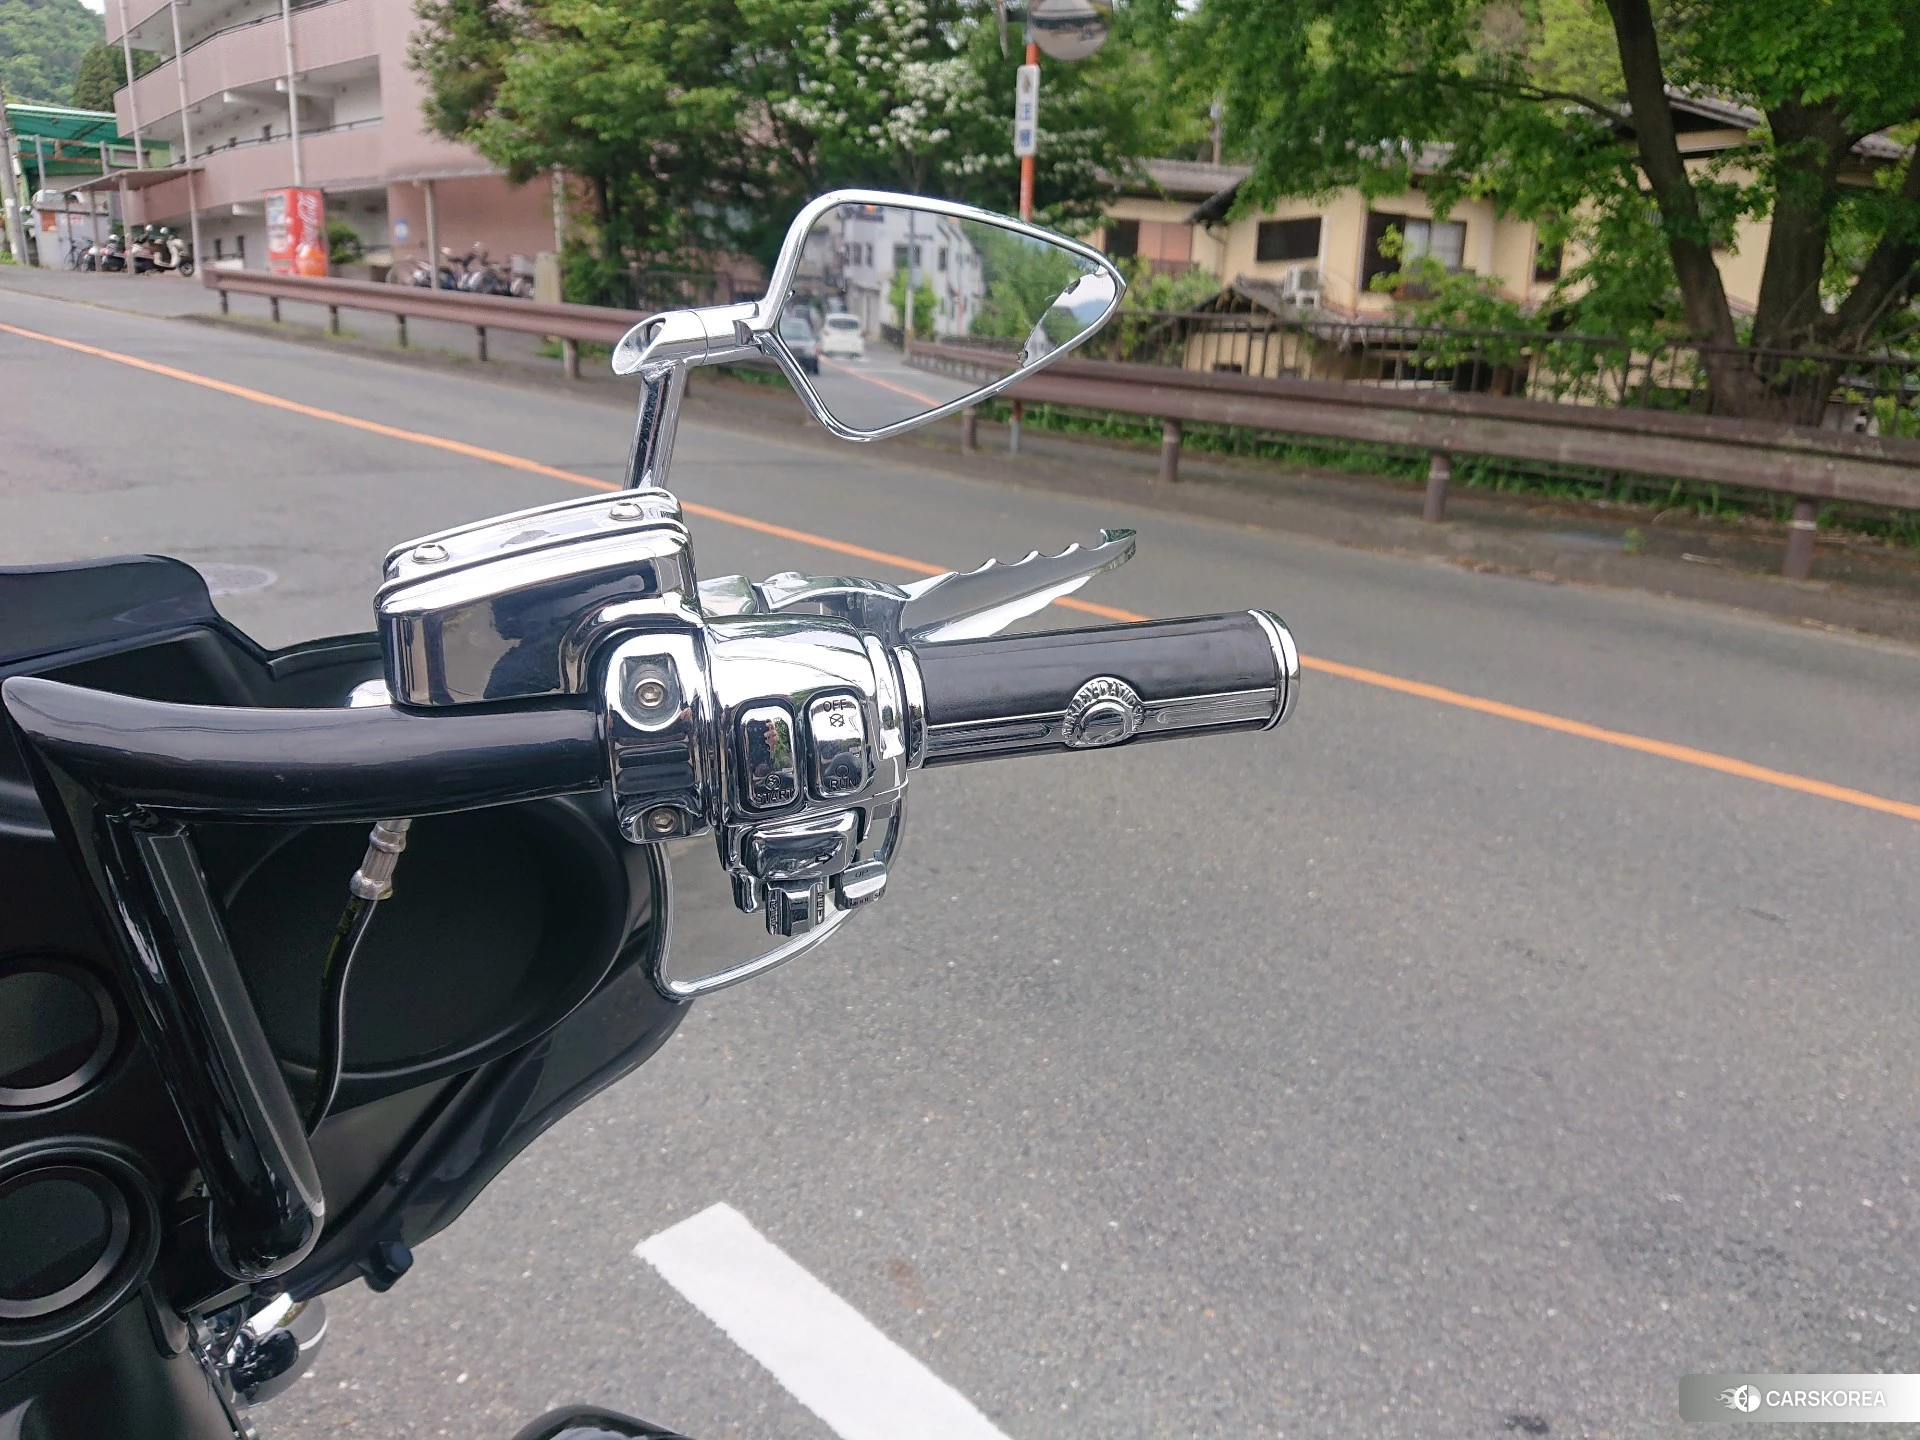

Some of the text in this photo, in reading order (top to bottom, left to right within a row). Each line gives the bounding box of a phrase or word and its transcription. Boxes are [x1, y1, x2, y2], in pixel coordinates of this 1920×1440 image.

[822, 698, 848, 713] OFF
[829, 778, 859, 791] RUN
[754, 788, 796, 805] START
